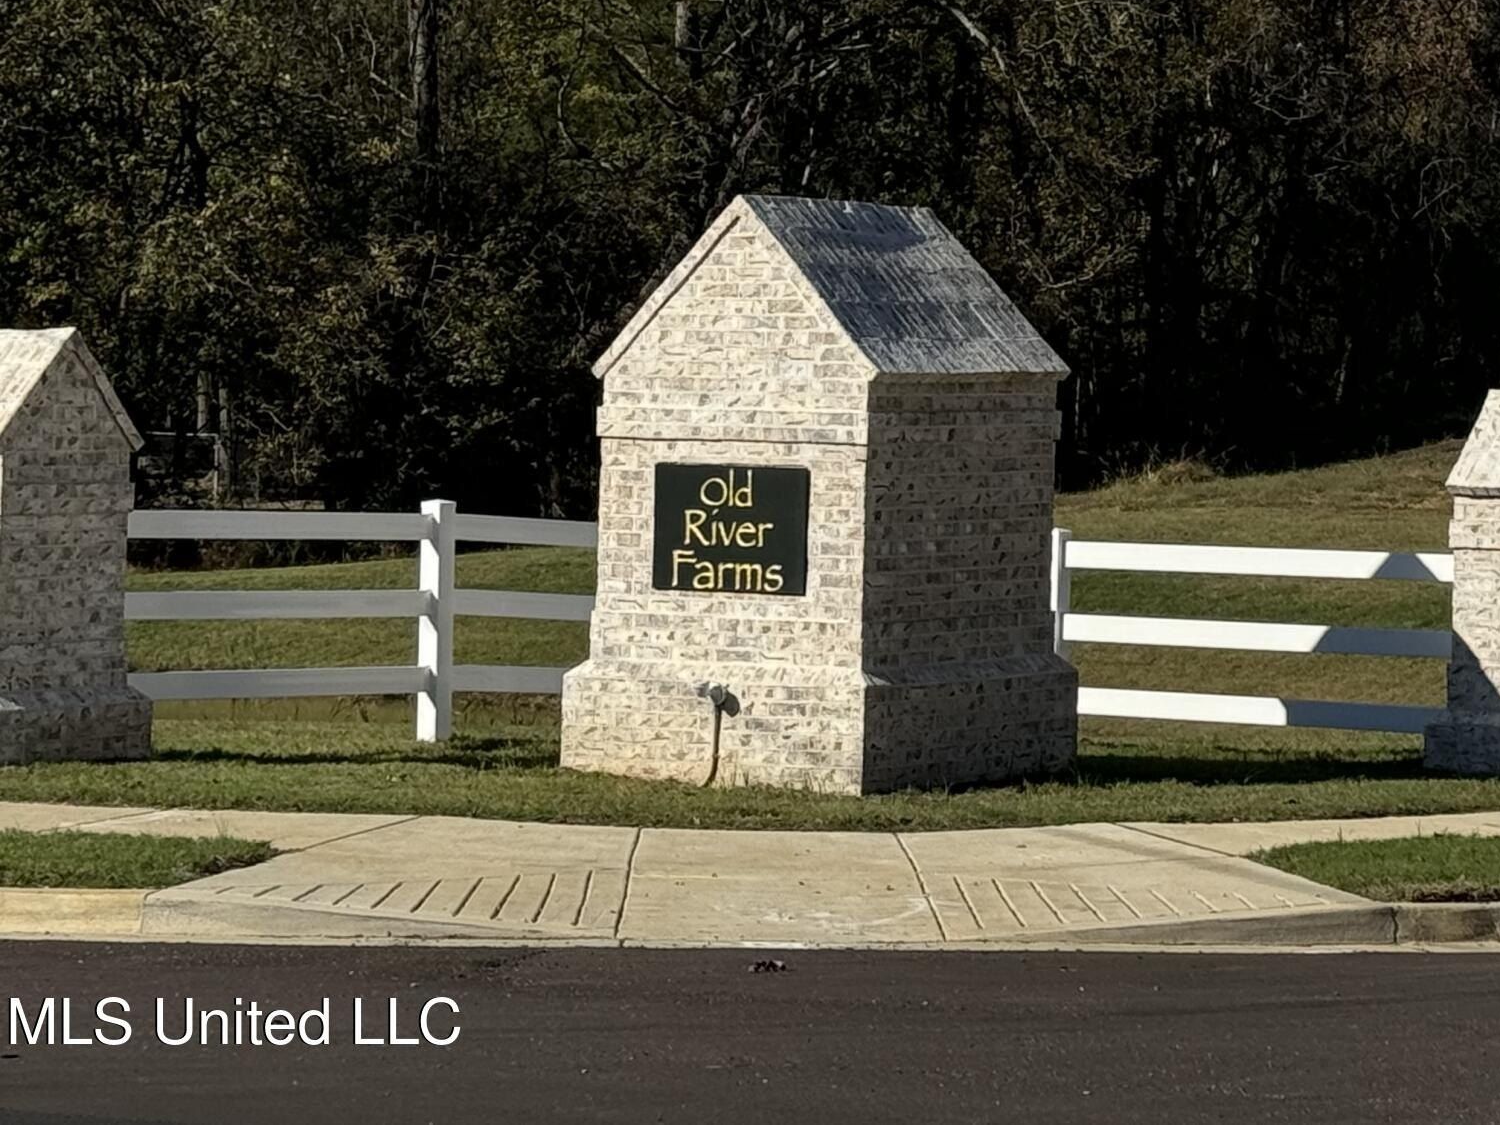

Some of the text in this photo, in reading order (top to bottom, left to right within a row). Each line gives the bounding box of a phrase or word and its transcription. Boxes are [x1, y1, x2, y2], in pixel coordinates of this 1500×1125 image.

[700, 468, 752, 507] Old
[684, 508, 774, 547] River
[671, 550, 784, 592] Farms
